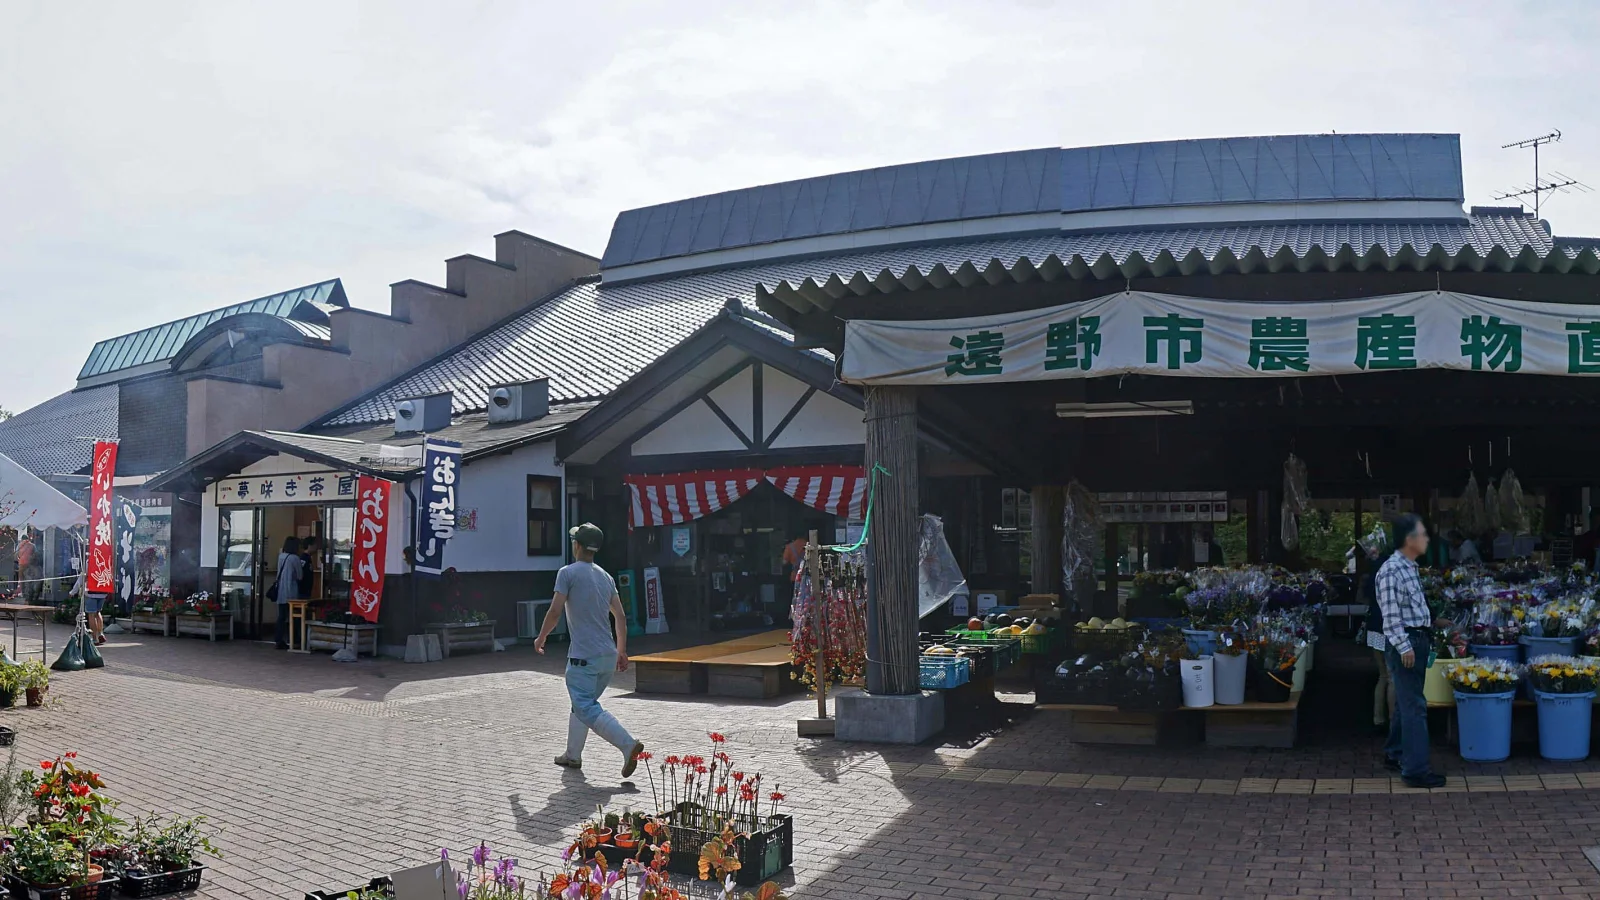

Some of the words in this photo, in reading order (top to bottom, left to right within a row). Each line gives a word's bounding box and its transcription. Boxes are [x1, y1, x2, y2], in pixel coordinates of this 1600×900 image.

[237, 475, 354, 500] 夢咲き茶屋
